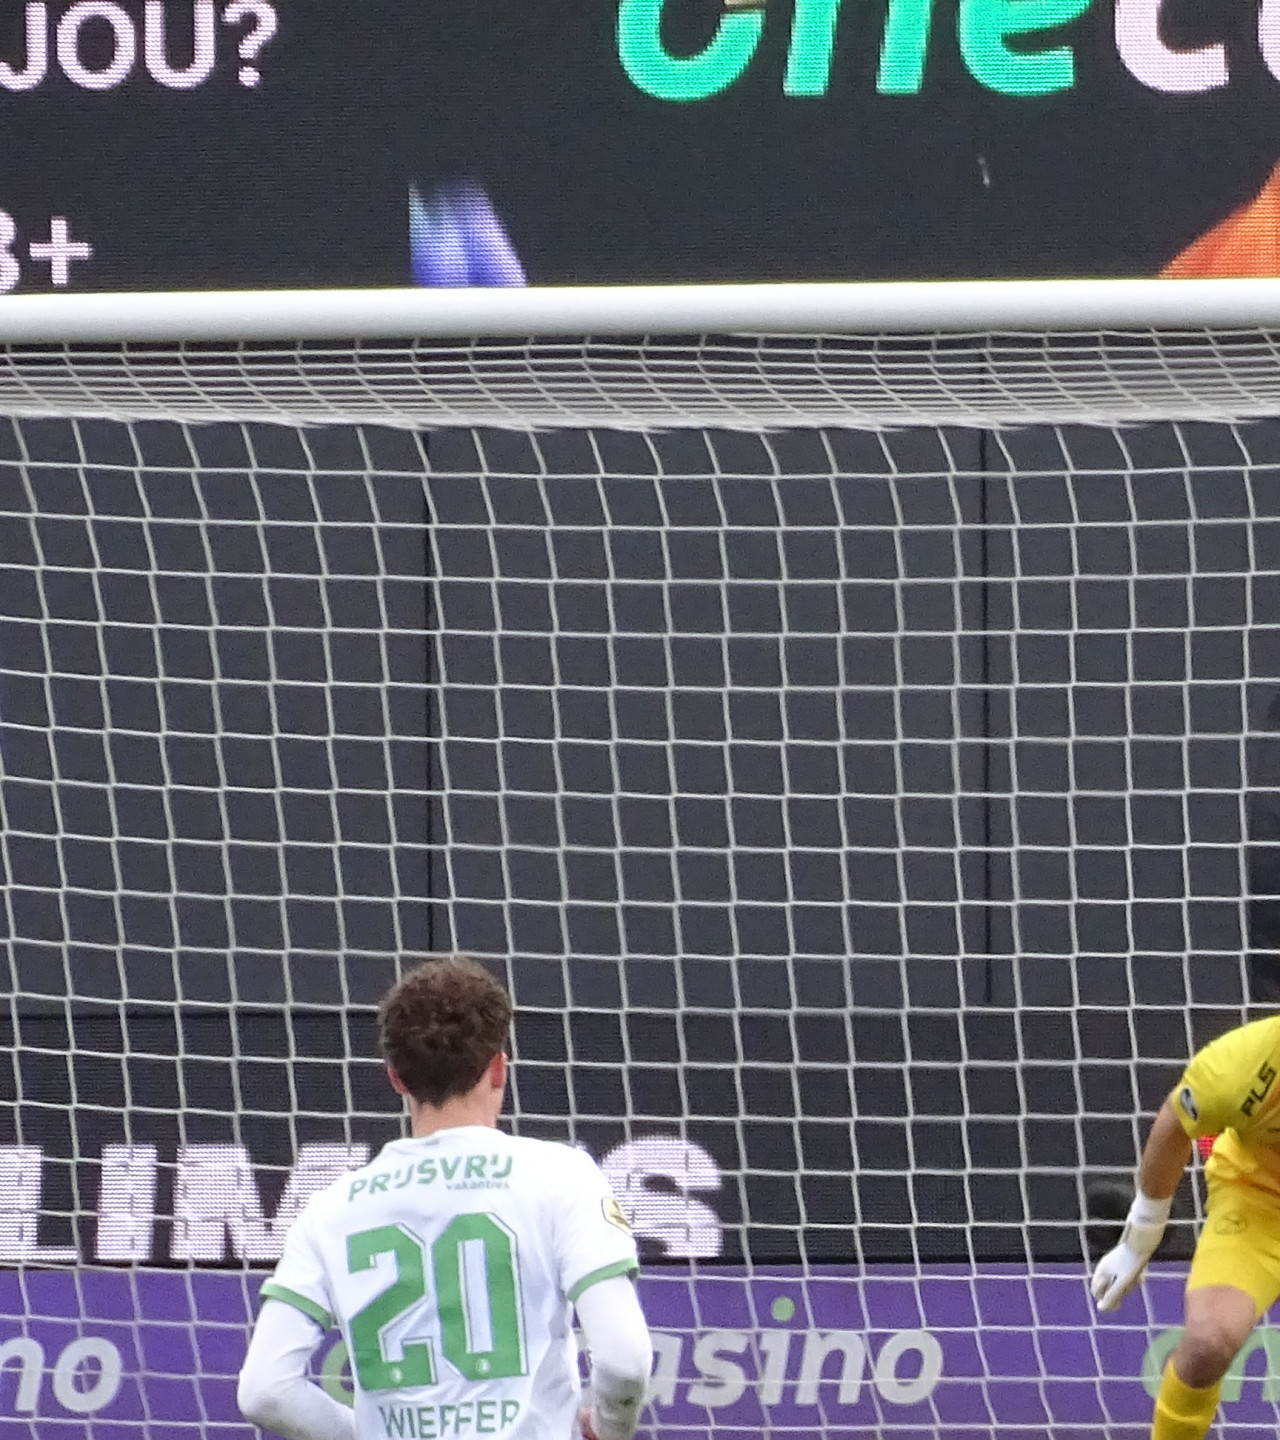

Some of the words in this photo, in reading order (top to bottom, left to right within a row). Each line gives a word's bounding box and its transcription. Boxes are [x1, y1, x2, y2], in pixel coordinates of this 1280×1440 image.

[0, 0, 278, 90] JOU?
[1239, 1061, 1277, 1117] PLS
[347, 1212, 527, 1391] 20
